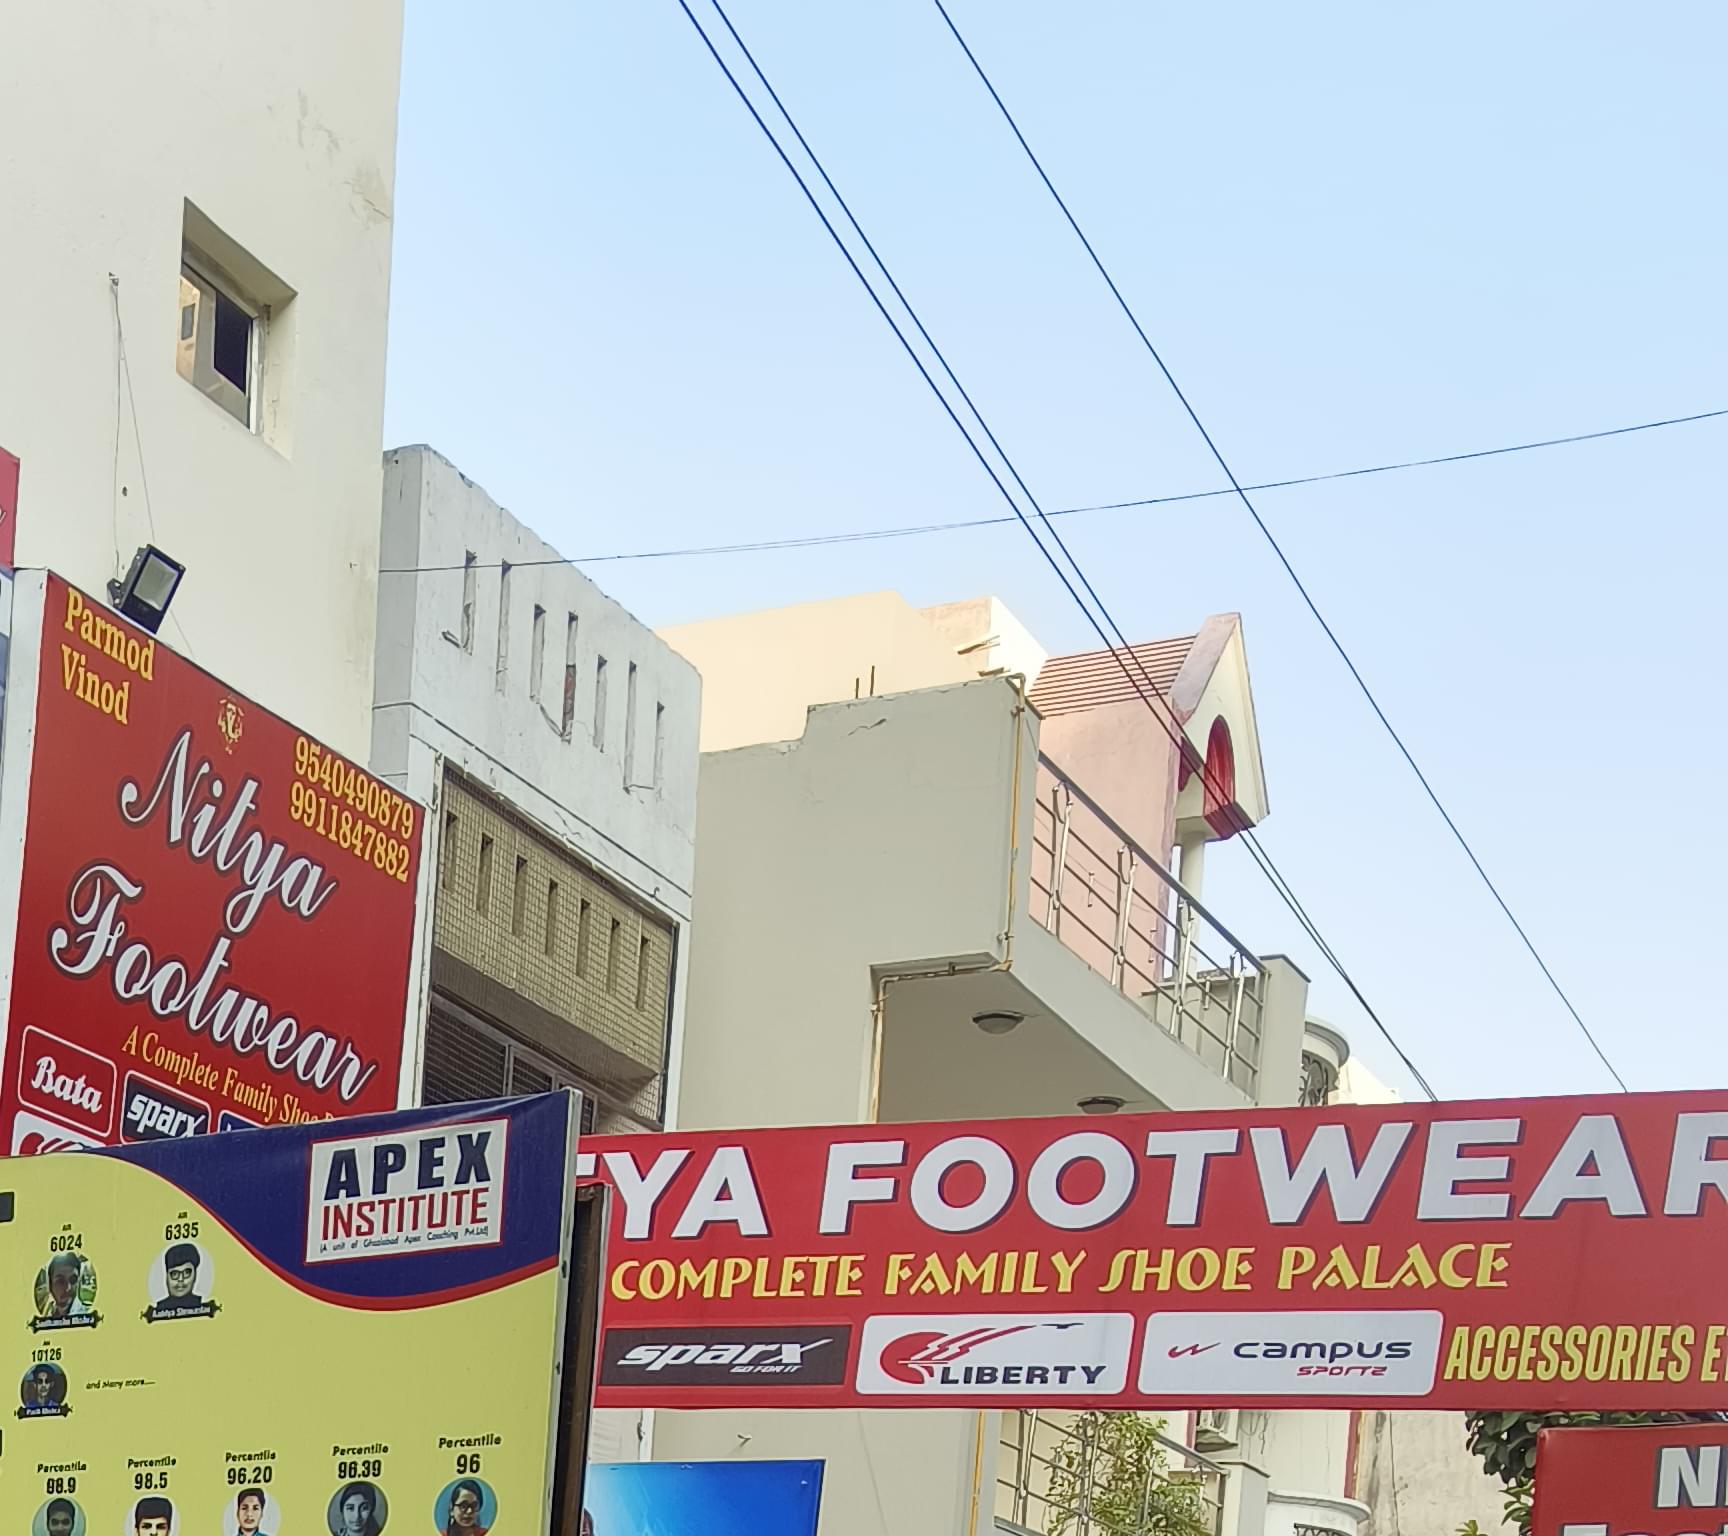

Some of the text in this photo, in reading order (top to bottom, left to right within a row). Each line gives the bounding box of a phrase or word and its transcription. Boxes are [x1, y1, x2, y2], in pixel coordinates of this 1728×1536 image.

[66, 587, 154, 682] Parmod
[61, 643, 128, 725] Vinod
[295, 736, 415, 840] 9540490879
[122, 729, 337, 933] Nitya
[291, 780, 409, 883] 9911847882
[50, 864, 380, 1103] Footwear
[30, 1055, 206, 1138] Bata sparx
[121, 1025, 139, 1056] A
[142, 1034, 217, 1090] Complete
[222, 1067, 279, 1123] Family
[324, 1131, 492, 1201] APEX
[576, 1146, 771, 1240] YA
[164, 1221, 200, 1241] 6335
[322, 1187, 489, 1241] INSTITUTE
[49, 1233, 83, 1253] 6024
[611, 1242, 1514, 1301] COMPLETE FAMILY SHOE PALACE
[31, 1347, 62, 1363] 10126
[617, 1338, 833, 1371] sparx
[939, 1362, 1104, 1388] LIBERTY
[1233, 1341, 1413, 1364] campus
[1443, 1325, 1696, 1382] ACCESSORIES
[332, 1442, 389, 1458] Percentile
[438, 1433, 503, 1451] Percentile
[455, 1453, 482, 1475] 96
[134, 1471, 169, 1491] 98.5
[227, 1465, 273, 1486] 96.20
